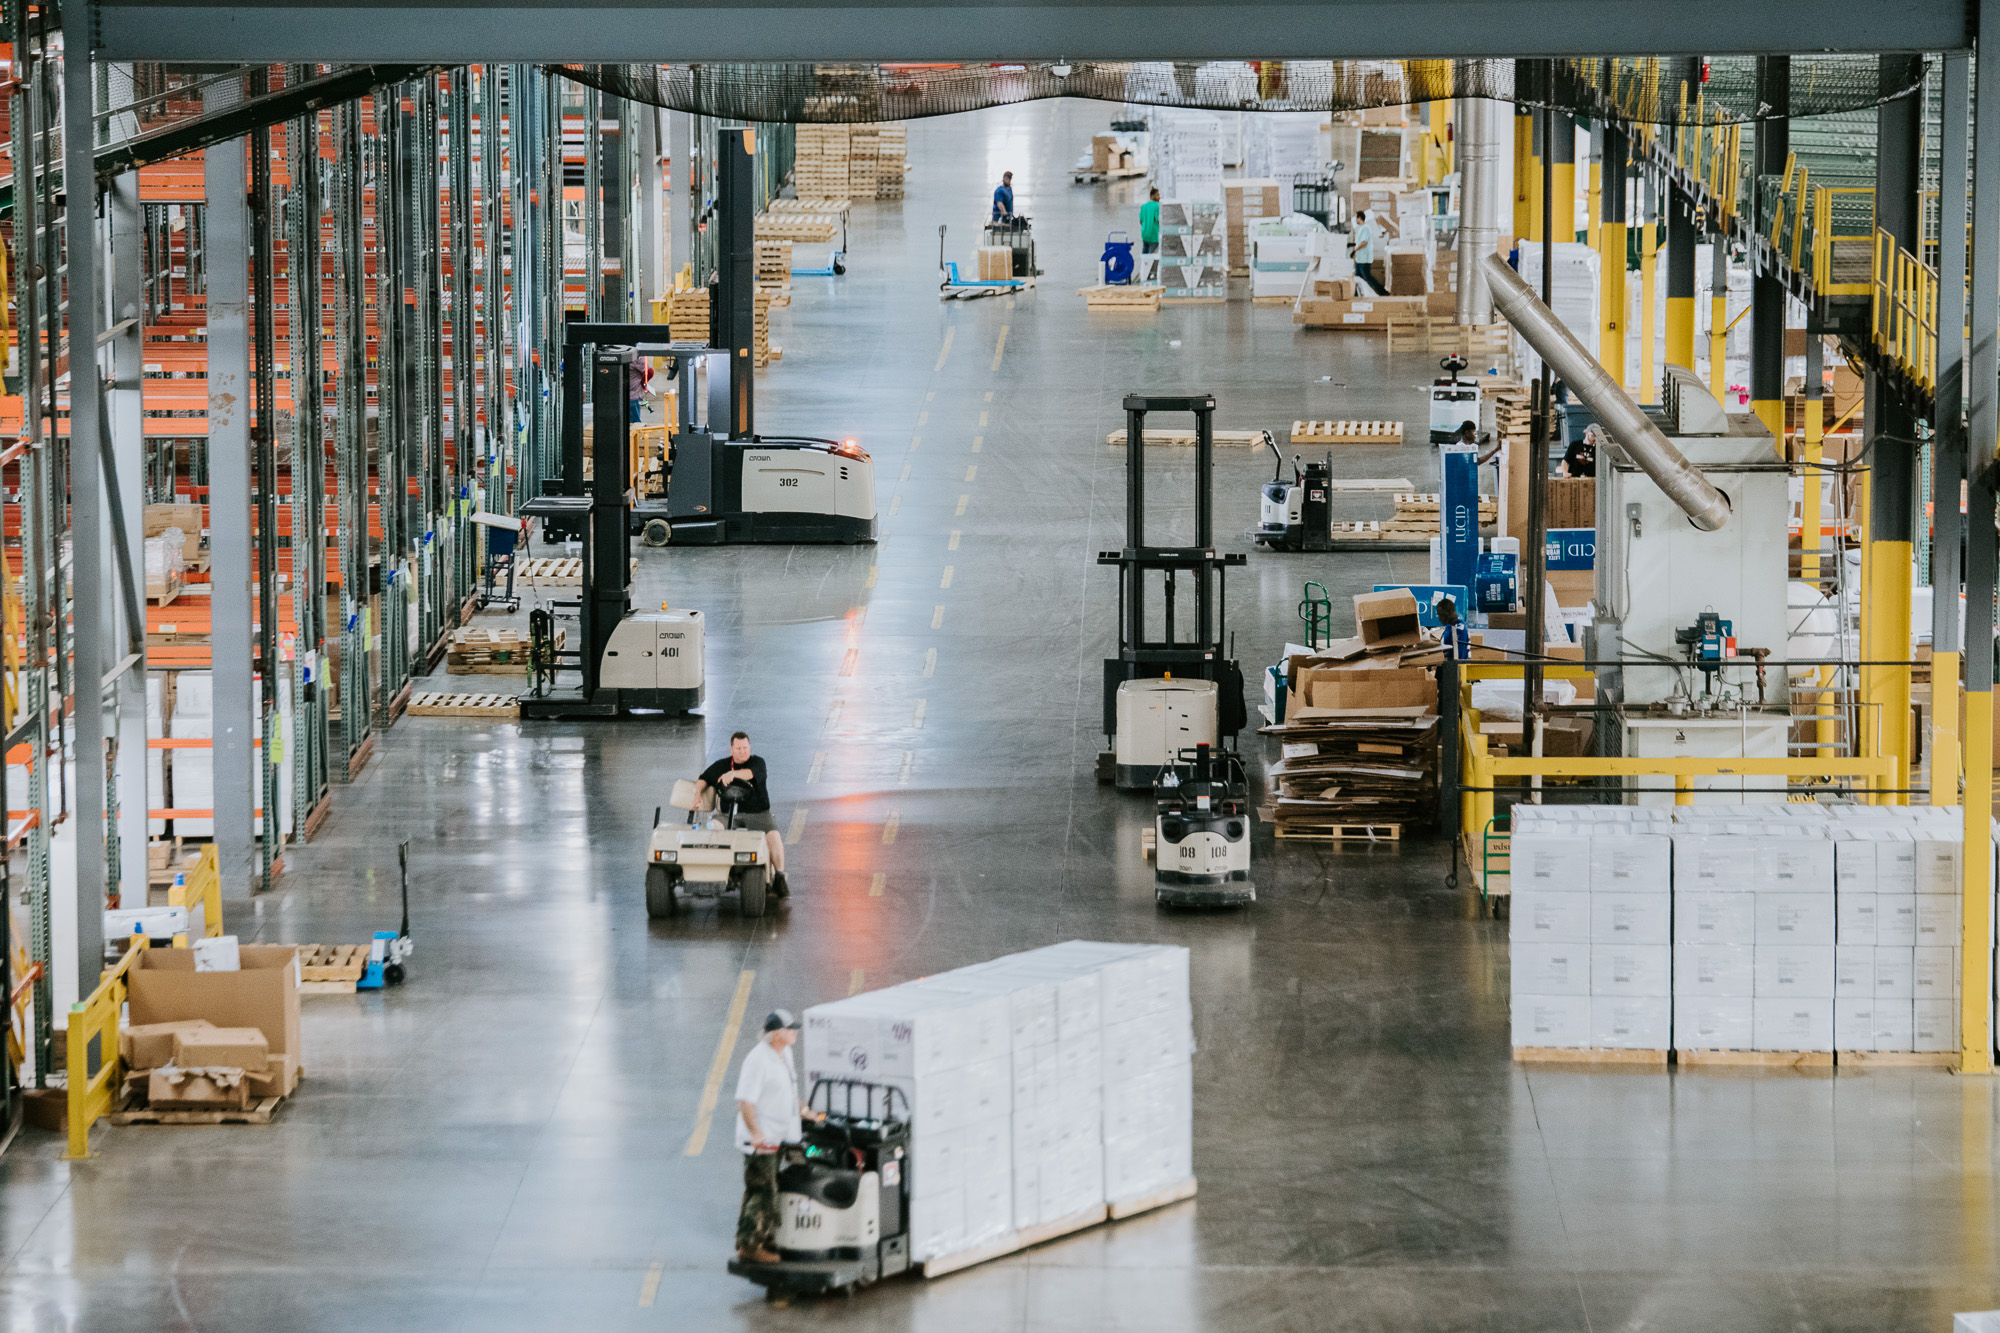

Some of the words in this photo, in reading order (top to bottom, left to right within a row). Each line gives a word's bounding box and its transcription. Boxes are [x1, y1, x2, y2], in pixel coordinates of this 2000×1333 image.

[779, 478, 799, 487] 302
[1455, 504, 1467, 543] LUCID
[1567, 543, 1596, 557] CID
[660, 647, 679, 658] 401
[1179, 845, 1196, 858] 108
[1211, 845, 1227, 859] 108
